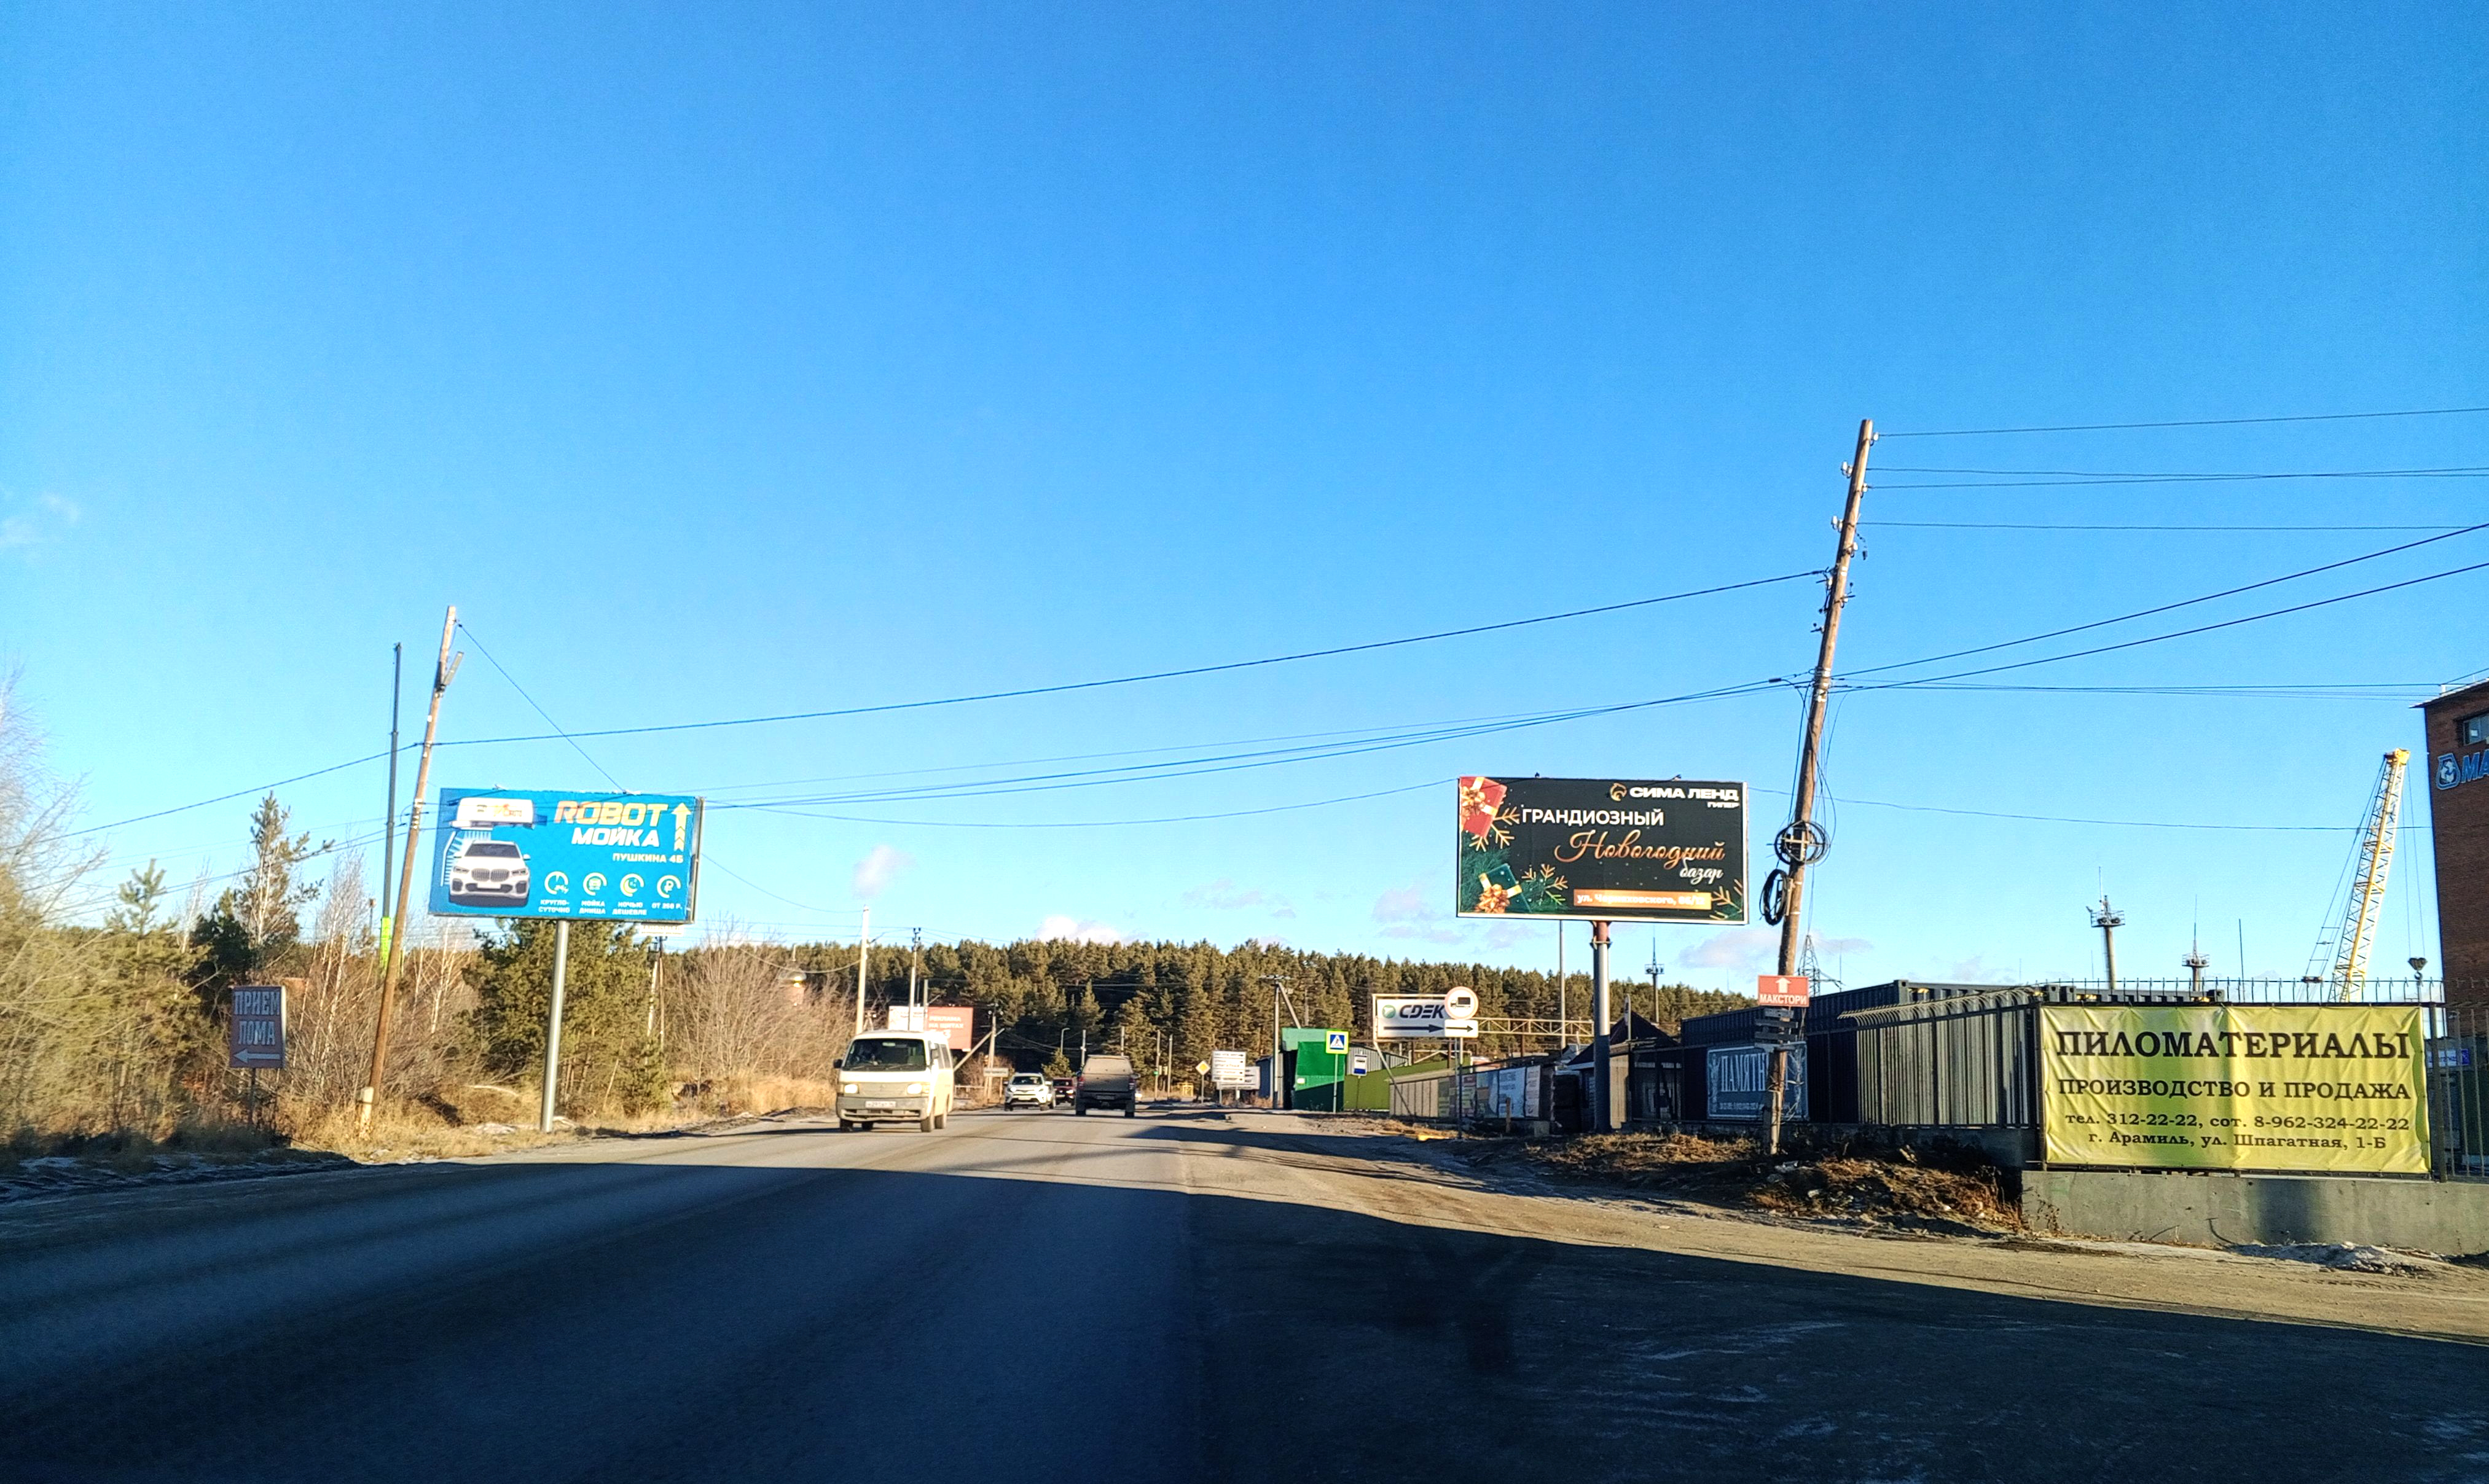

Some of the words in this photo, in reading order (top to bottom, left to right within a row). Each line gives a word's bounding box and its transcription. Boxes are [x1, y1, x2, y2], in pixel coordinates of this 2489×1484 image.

[1629, 787, 1686, 799] СИМА
[1688, 788, 1739, 802] ЛЕНД
[554, 800, 668, 827] ROBOT
[1522, 808, 1664, 826] ГРАНДИОЗНЫЙ
[571, 827, 660, 848] МОЙКА
[613, 853, 667, 863] ПУШКИНА
[1554, 829, 1725, 870] Новогодний
[1680, 854, 1724, 885] базар
[1577, 894, 1593, 904] ул.
[1594, 894, 1677, 905] Черняховского,
[233, 991, 280, 1015] ПРИЕМ
[1759, 993, 1808, 1005] МАКСТОРИ
[1399, 1004, 1445, 1019] CDEK
[238, 1020, 276, 1045] ЛОМА
[2056, 1031, 2410, 1060] ПИЛОМАТЕРИАЛЫ
[2058, 1079, 2250, 1099] ПРОИЗВОДСТВО
[2259, 1082, 2275, 1097] И
[2284, 1082, 2412, 1101] ПРОДАЖА
[2065, 1114, 2100, 1125] тел.
[2107, 1113, 2203, 1129] 312-22-22,
[2209, 1117, 2247, 1128] сот.
[2254, 1115, 2410, 1131] 8-962-324-22-22
[2088, 1133, 2103, 1142] г.
[2109, 1131, 2195, 1147] Арамиль,
[2200, 1136, 2227, 1148] ул.
[2233, 1134, 2349, 1150] Шпагатная,
[2356, 1136, 2386, 1149] 1-Б
